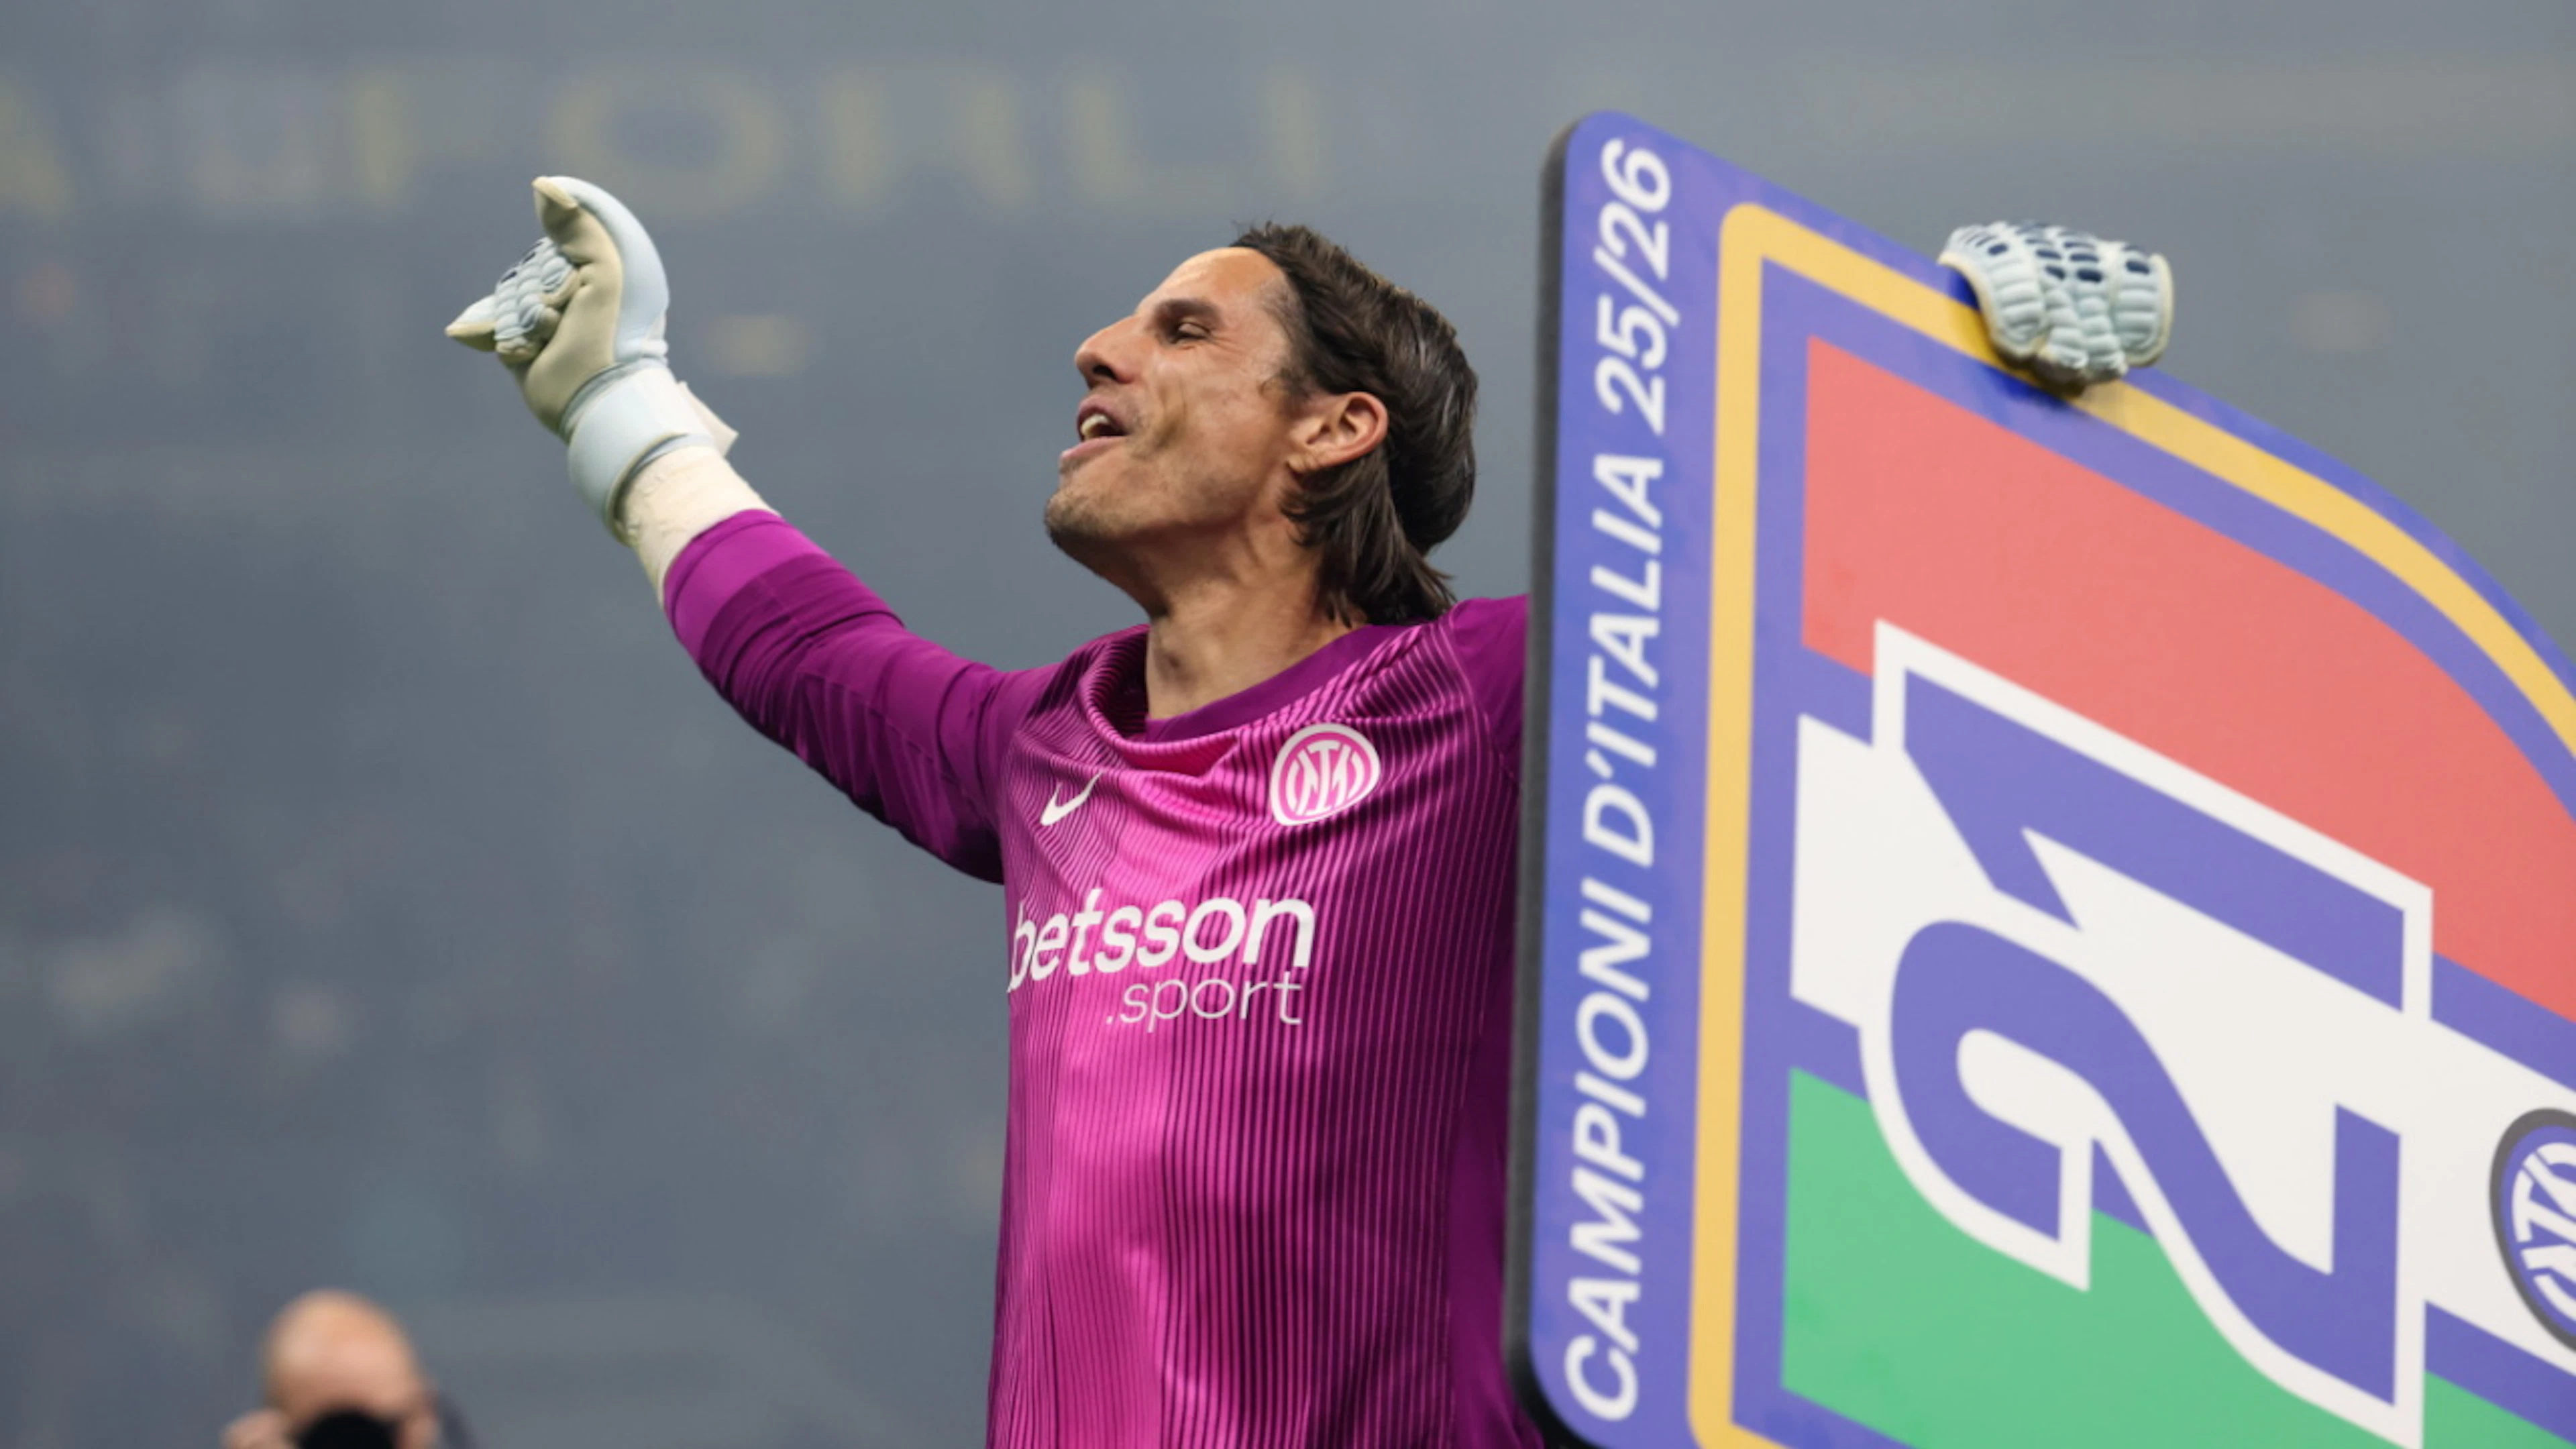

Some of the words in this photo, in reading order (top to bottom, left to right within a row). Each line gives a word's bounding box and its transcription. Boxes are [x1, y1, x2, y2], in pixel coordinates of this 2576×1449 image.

[1593, 138, 1682, 435] 25/26
[1583, 453, 1664, 867] D'ITALIA
[1007, 888, 1316, 994] betsson
[1106, 971, 1302, 1034] .sport
[1889, 667, 2405, 1407] 21
[1564, 877, 1652, 1421] CAMPIONI
